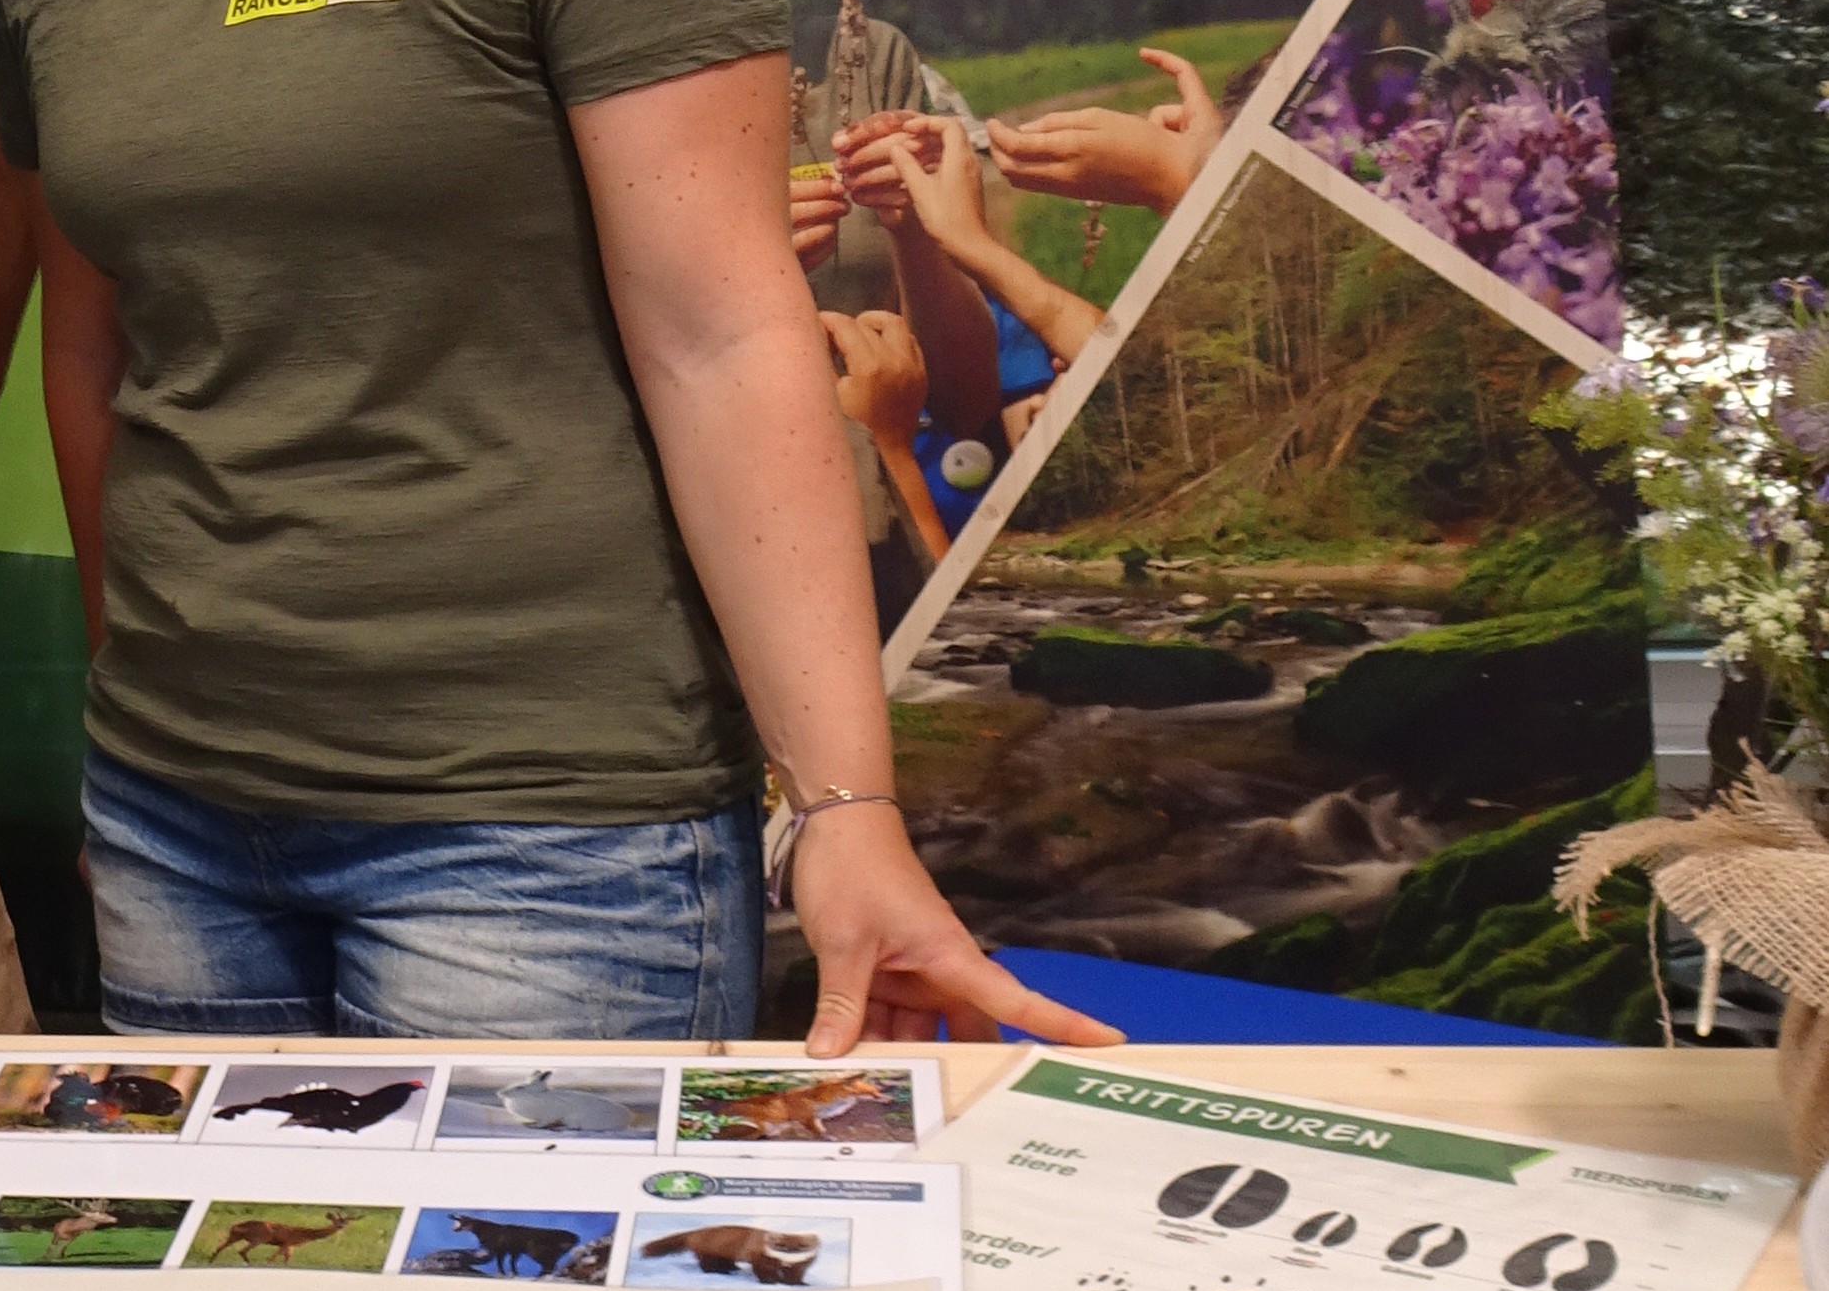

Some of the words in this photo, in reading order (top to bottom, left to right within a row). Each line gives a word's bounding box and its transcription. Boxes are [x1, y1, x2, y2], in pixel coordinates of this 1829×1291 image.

[1074, 1074, 1394, 1152] TRITTSPUREN
[1006, 1152, 1079, 1177] tiere
[1021, 1139, 1089, 1160] Huf-
[1570, 1166, 1730, 1203] TIERSPUREN
[962, 1228, 1061, 1259] arder/
